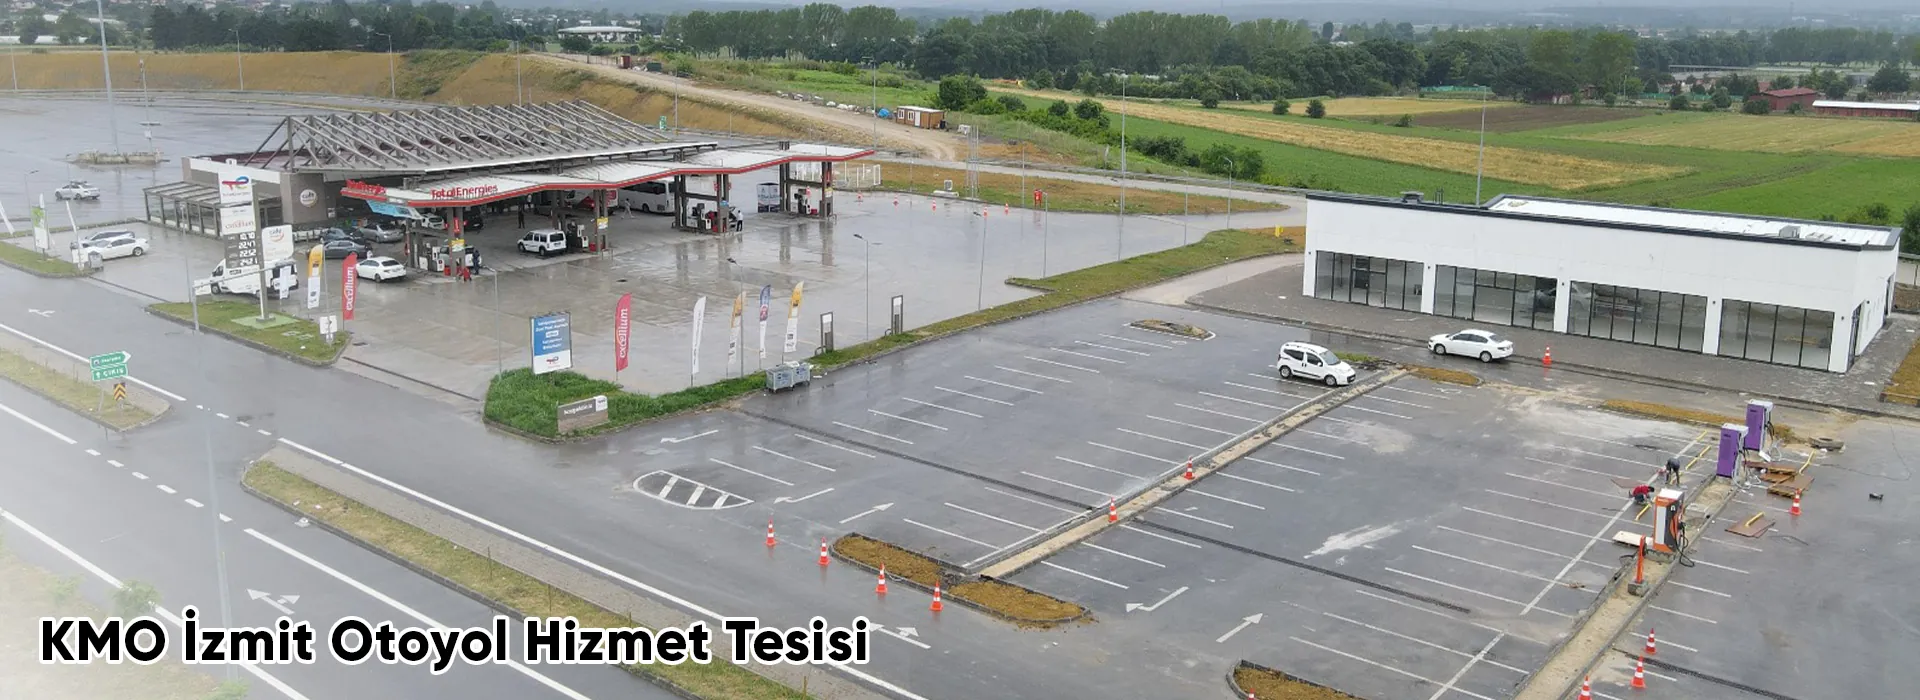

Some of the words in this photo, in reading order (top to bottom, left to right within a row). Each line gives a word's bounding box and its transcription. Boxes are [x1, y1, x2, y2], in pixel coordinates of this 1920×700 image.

[431, 184, 498, 199] TotalEnergies
[344, 266, 355, 310] excellium
[617, 308, 628, 358] excellium
